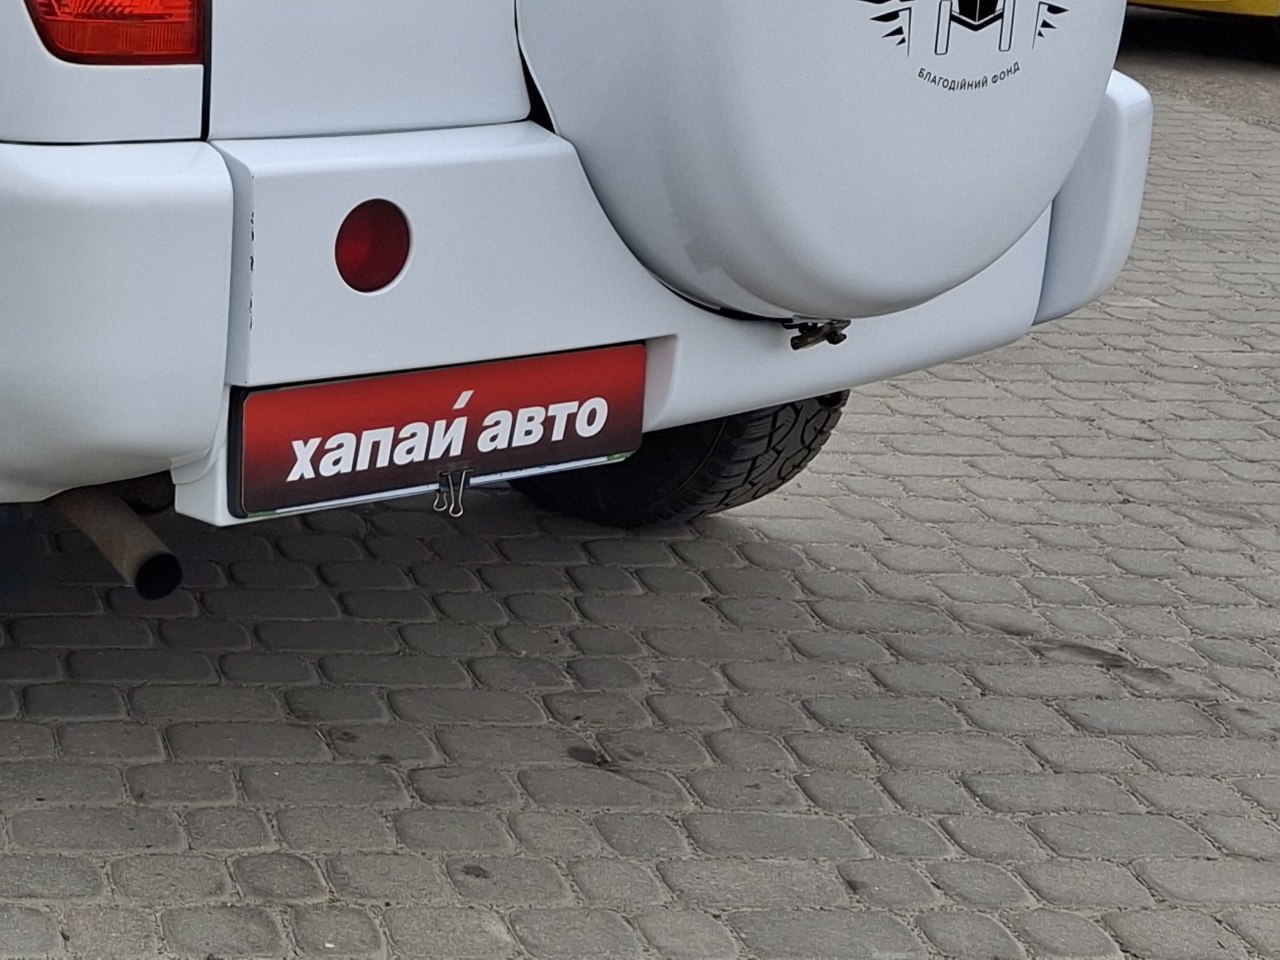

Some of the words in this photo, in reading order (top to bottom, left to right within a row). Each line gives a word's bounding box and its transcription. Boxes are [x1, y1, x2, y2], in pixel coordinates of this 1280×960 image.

[918, 68, 987, 91] БЛАГОДІЙНИЙ
[991, 61, 1020, 84] ФОНД
[477, 397, 608, 453] авто
